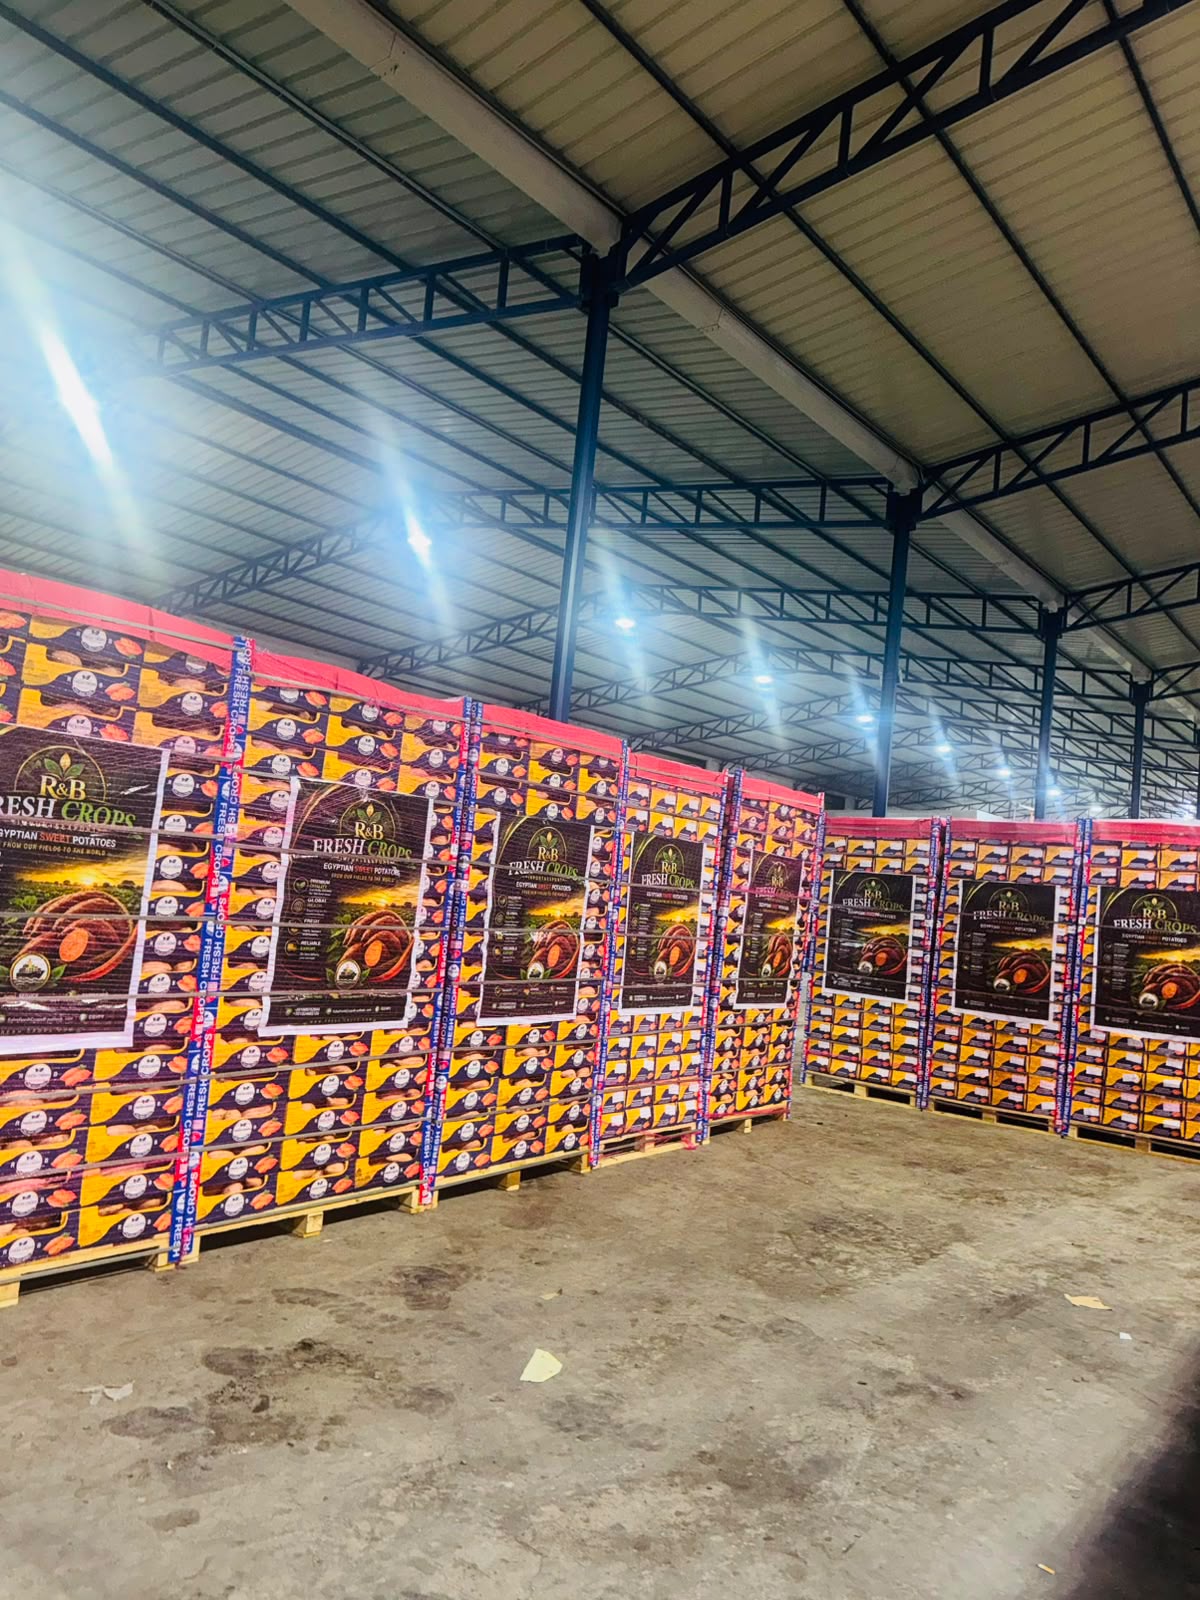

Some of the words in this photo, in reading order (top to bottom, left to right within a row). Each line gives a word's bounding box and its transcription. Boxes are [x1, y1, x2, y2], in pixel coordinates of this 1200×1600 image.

[243, 638, 252, 672] CROP
[232, 668, 243, 707] FRESH
[239, 676, 249, 714] FRESH
[227, 710, 238, 751] CROPS
[39, 774, 86, 801] R&B
[230, 764, 240, 805] CROPS
[61, 801, 136, 829] CROPS
[354, 821, 384, 840] R&B
[40, 832, 71, 843] SWEET
[72, 836, 116, 848] POTATOES
[313, 838, 365, 855] FRESH
[367, 840, 413, 859] CROPS
[538, 847, 559, 861] R&B
[211, 844, 223, 886] CROPS
[323, 862, 354, 872] EGYPTIAN
[508, 861, 545, 875] FRESH
[545, 862, 578, 878] CROPS
[641, 873, 668, 886] FRESH
[669, 875, 695, 888] CROPS
[661, 861, 677, 874] R&B
[215, 898, 227, 938] CROPS
[842, 898, 871, 907] FRESH
[872, 900, 904, 910] CROPS
[973, 910, 1006, 920] FRESH
[1143, 908, 1167, 919] R&B
[451, 907, 459, 939] CROS
[1113, 919, 1152, 929] FRESH
[1155, 920, 1197, 934] CROPS
[201, 938, 212, 978] FRESH
[211, 941, 222, 980] FRESH
[440, 934, 449, 968] CROPS
[433, 1011, 441, 1043] FRESH
[201, 1033, 213, 1075] CROPS
[196, 1079, 208, 1118] FRESH
[431, 1131, 440, 1164] FRESH
[187, 1172, 198, 1214] CROPS
[172, 1216, 183, 1258] FRESH
[183, 1217, 194, 1254] REH
